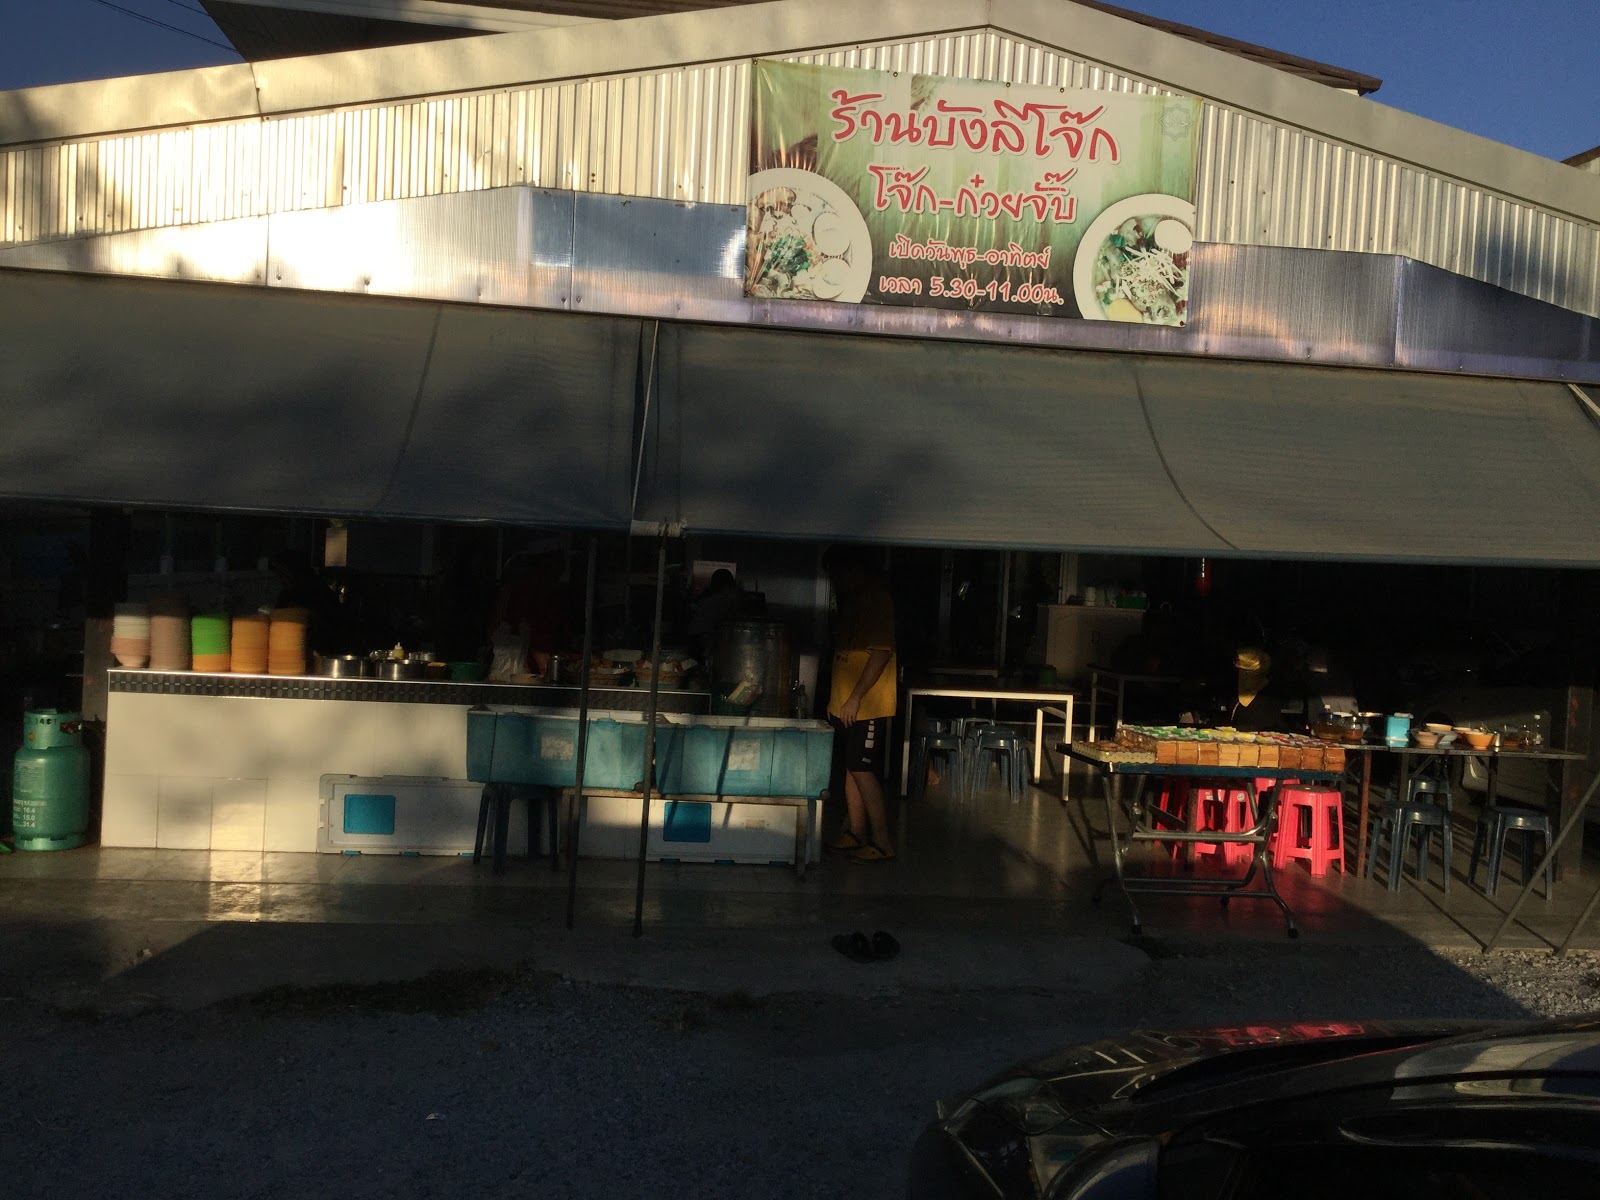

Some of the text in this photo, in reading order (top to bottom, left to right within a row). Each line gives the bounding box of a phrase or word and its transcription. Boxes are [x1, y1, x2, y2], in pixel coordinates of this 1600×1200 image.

[869, 166, 1075, 220] โจ๊ก-ก๋วยจั๊บ
[889, 233, 1052, 270] เปิดวันพุธ-อาทิตย์
[879, 276, 922, 294] เวลา
